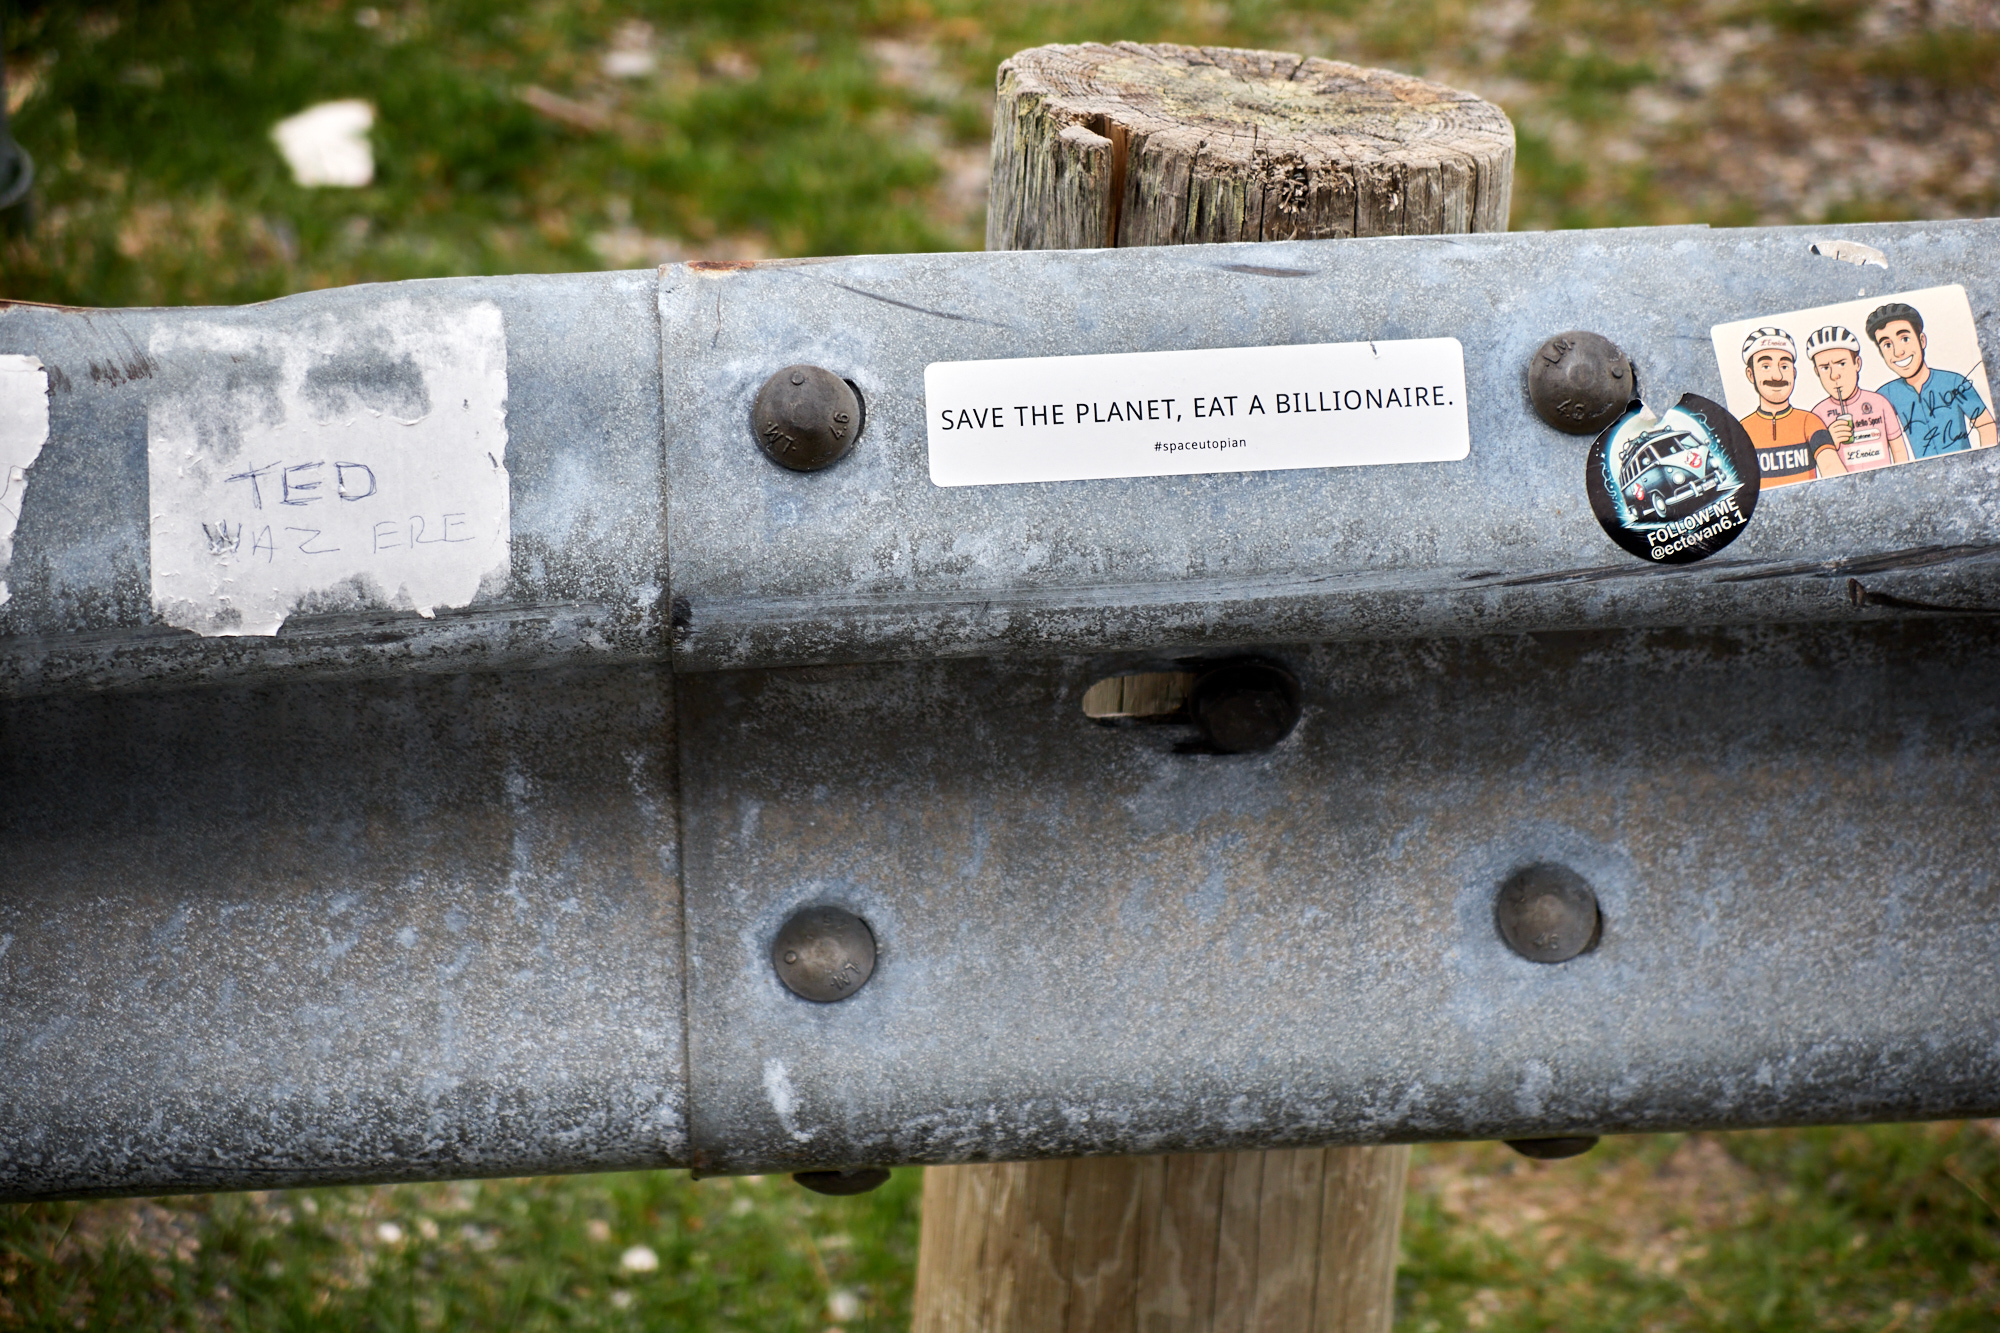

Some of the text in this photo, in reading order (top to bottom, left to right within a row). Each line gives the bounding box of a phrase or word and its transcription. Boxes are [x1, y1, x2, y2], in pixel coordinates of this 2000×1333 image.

[941, 384, 1453, 431] SAVE THE PLANET, EAT A BILLIONAIRE.
[1154, 439, 1247, 454] #spaceutopian
[1756, 447, 1810, 472] OLTENI
[1847, 448, 1881, 460] L'Eroica
[224, 460, 377, 510] TED
[202, 513, 476, 563] WAZ ERE
[1647, 495, 1740, 547] FOLLOW ME
[1650, 509, 1748, 560] @ectovan6.1
